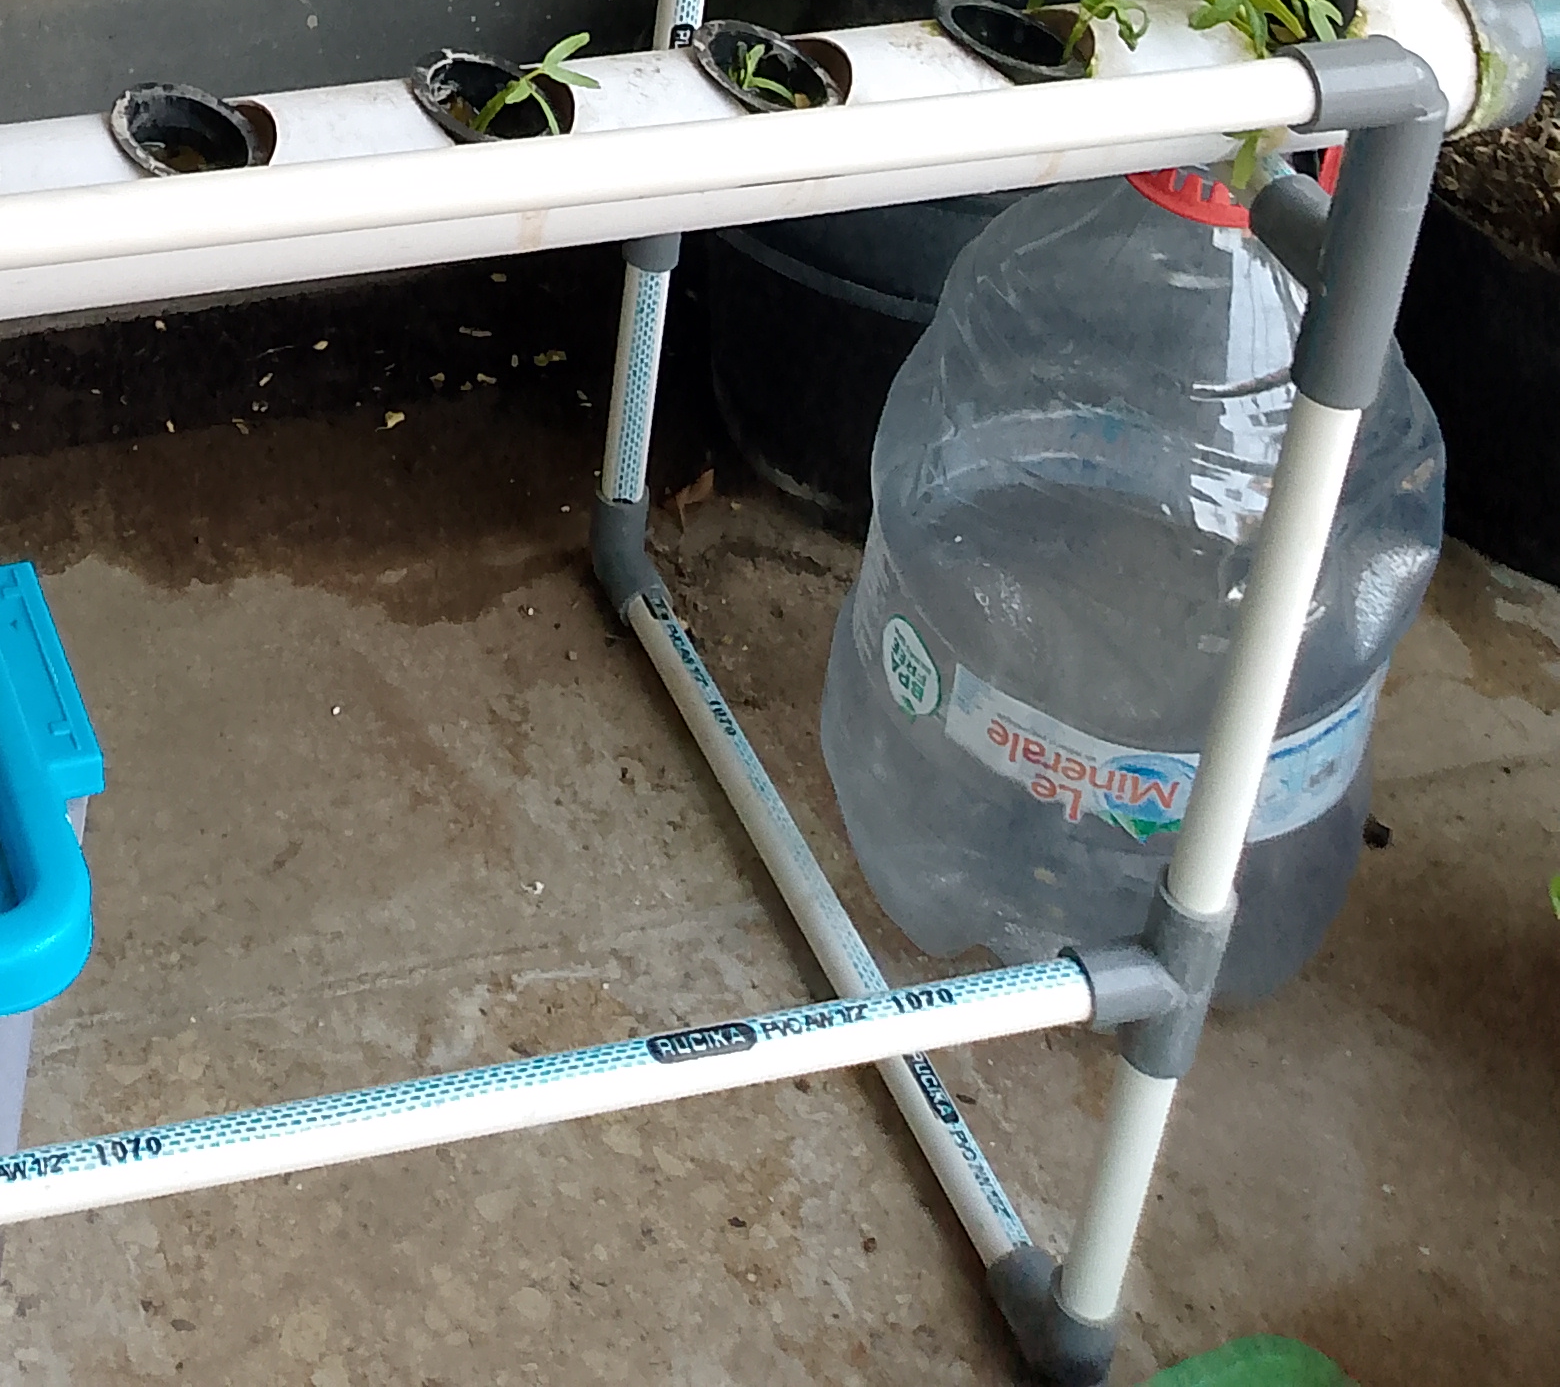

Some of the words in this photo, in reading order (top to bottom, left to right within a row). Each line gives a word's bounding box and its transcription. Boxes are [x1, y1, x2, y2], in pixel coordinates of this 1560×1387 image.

[891, 651, 924, 703] BPA
[987, 719, 1180, 809] Minerale
[1031, 773, 1082, 820] Le
[657, 1026, 746, 1058] RUCIKA
[891, 987, 954, 1013] 1070
[95, 1136, 162, 1166] 1070
